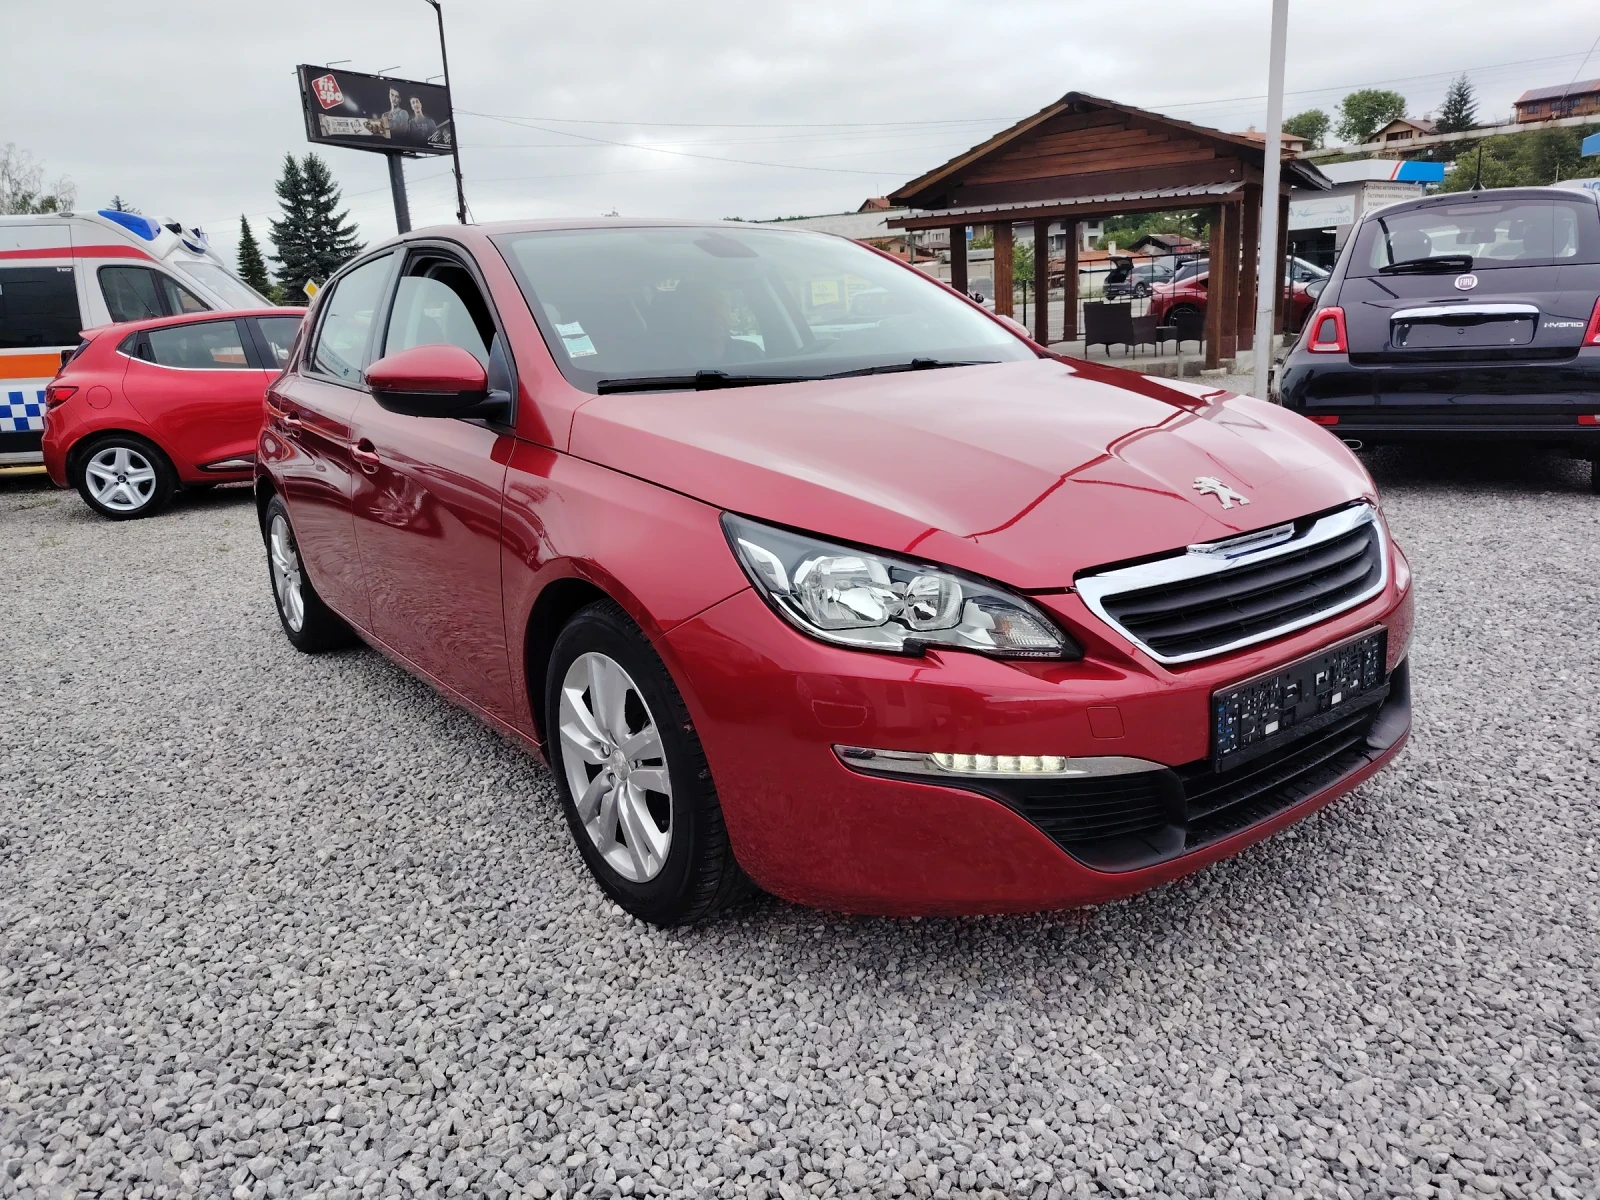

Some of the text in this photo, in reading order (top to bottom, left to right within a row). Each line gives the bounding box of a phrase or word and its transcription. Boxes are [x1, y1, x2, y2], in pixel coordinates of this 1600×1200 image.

[318, 78, 334, 91] fit
[320, 90, 343, 103] spo
[1290, 215, 1350, 228] ETAILING STUDIO
[1459, 277, 1474, 287] FIAT
